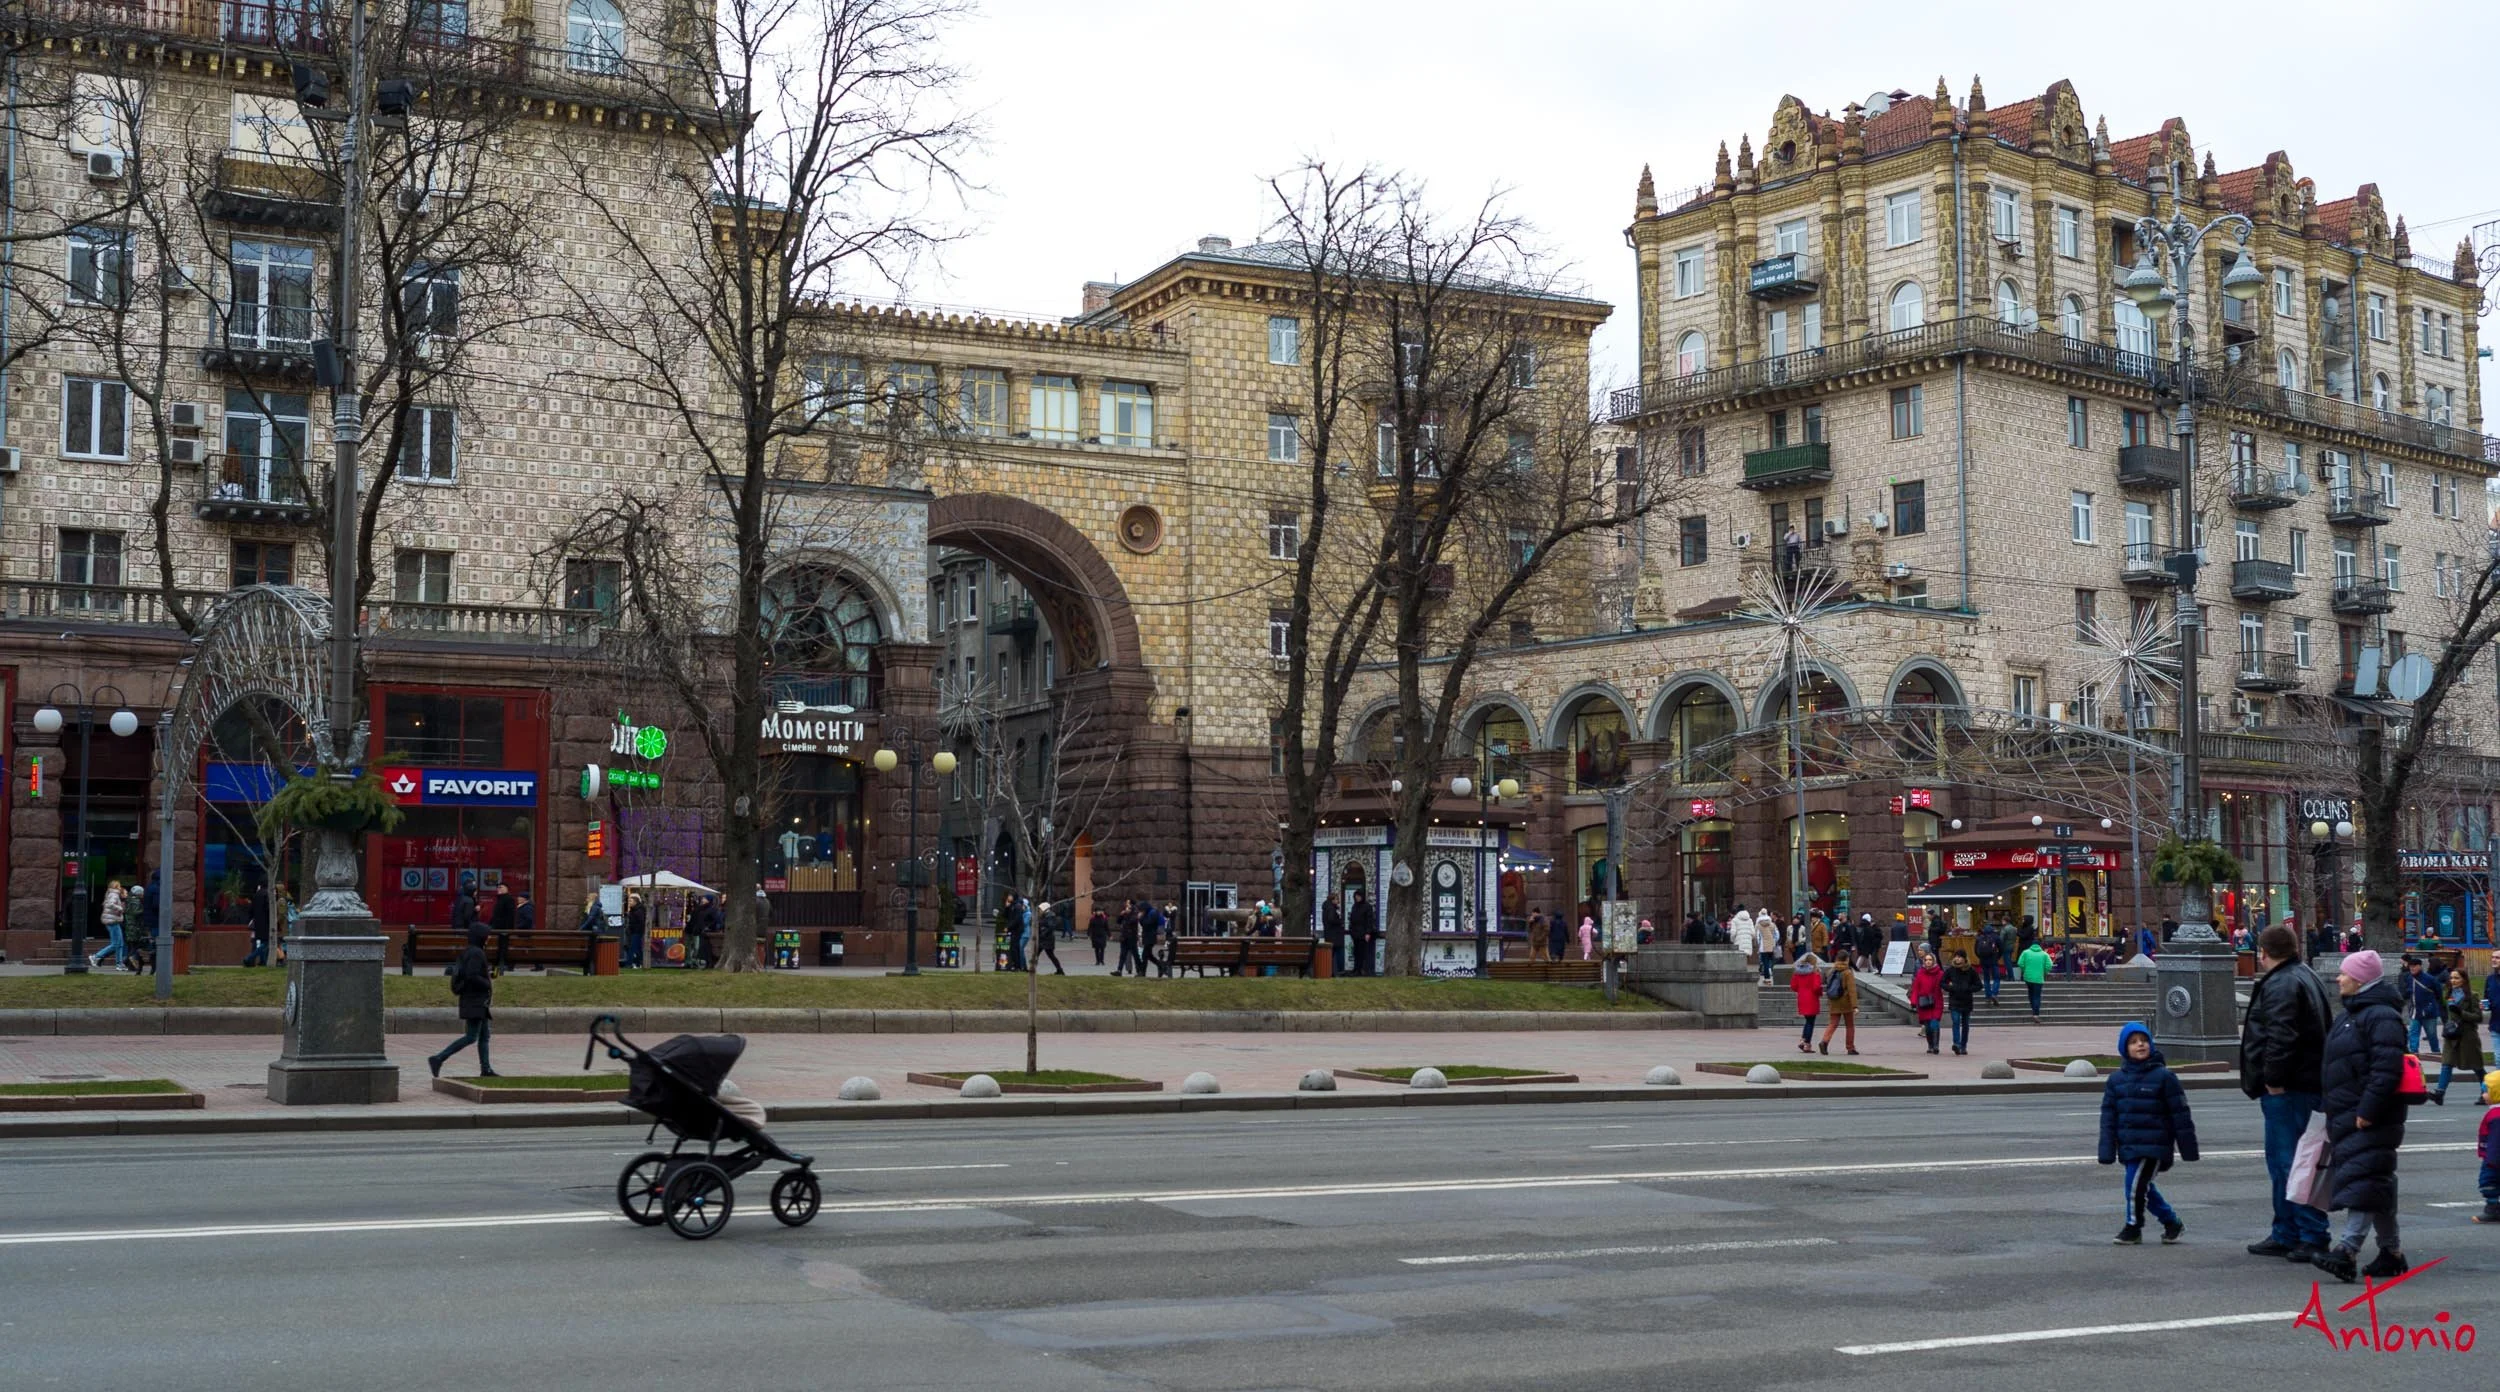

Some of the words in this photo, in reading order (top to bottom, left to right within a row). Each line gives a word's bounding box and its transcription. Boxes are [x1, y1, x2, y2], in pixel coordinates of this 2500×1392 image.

[761, 712, 864, 741] Моменти
[782, 742, 817, 752] сімейне
[827, 743, 849, 755] кафе
[428, 779, 534, 796] FAVORIT
[2303, 799, 2349, 820] COLIN'S
[1909, 916, 1922, 924] SALE
